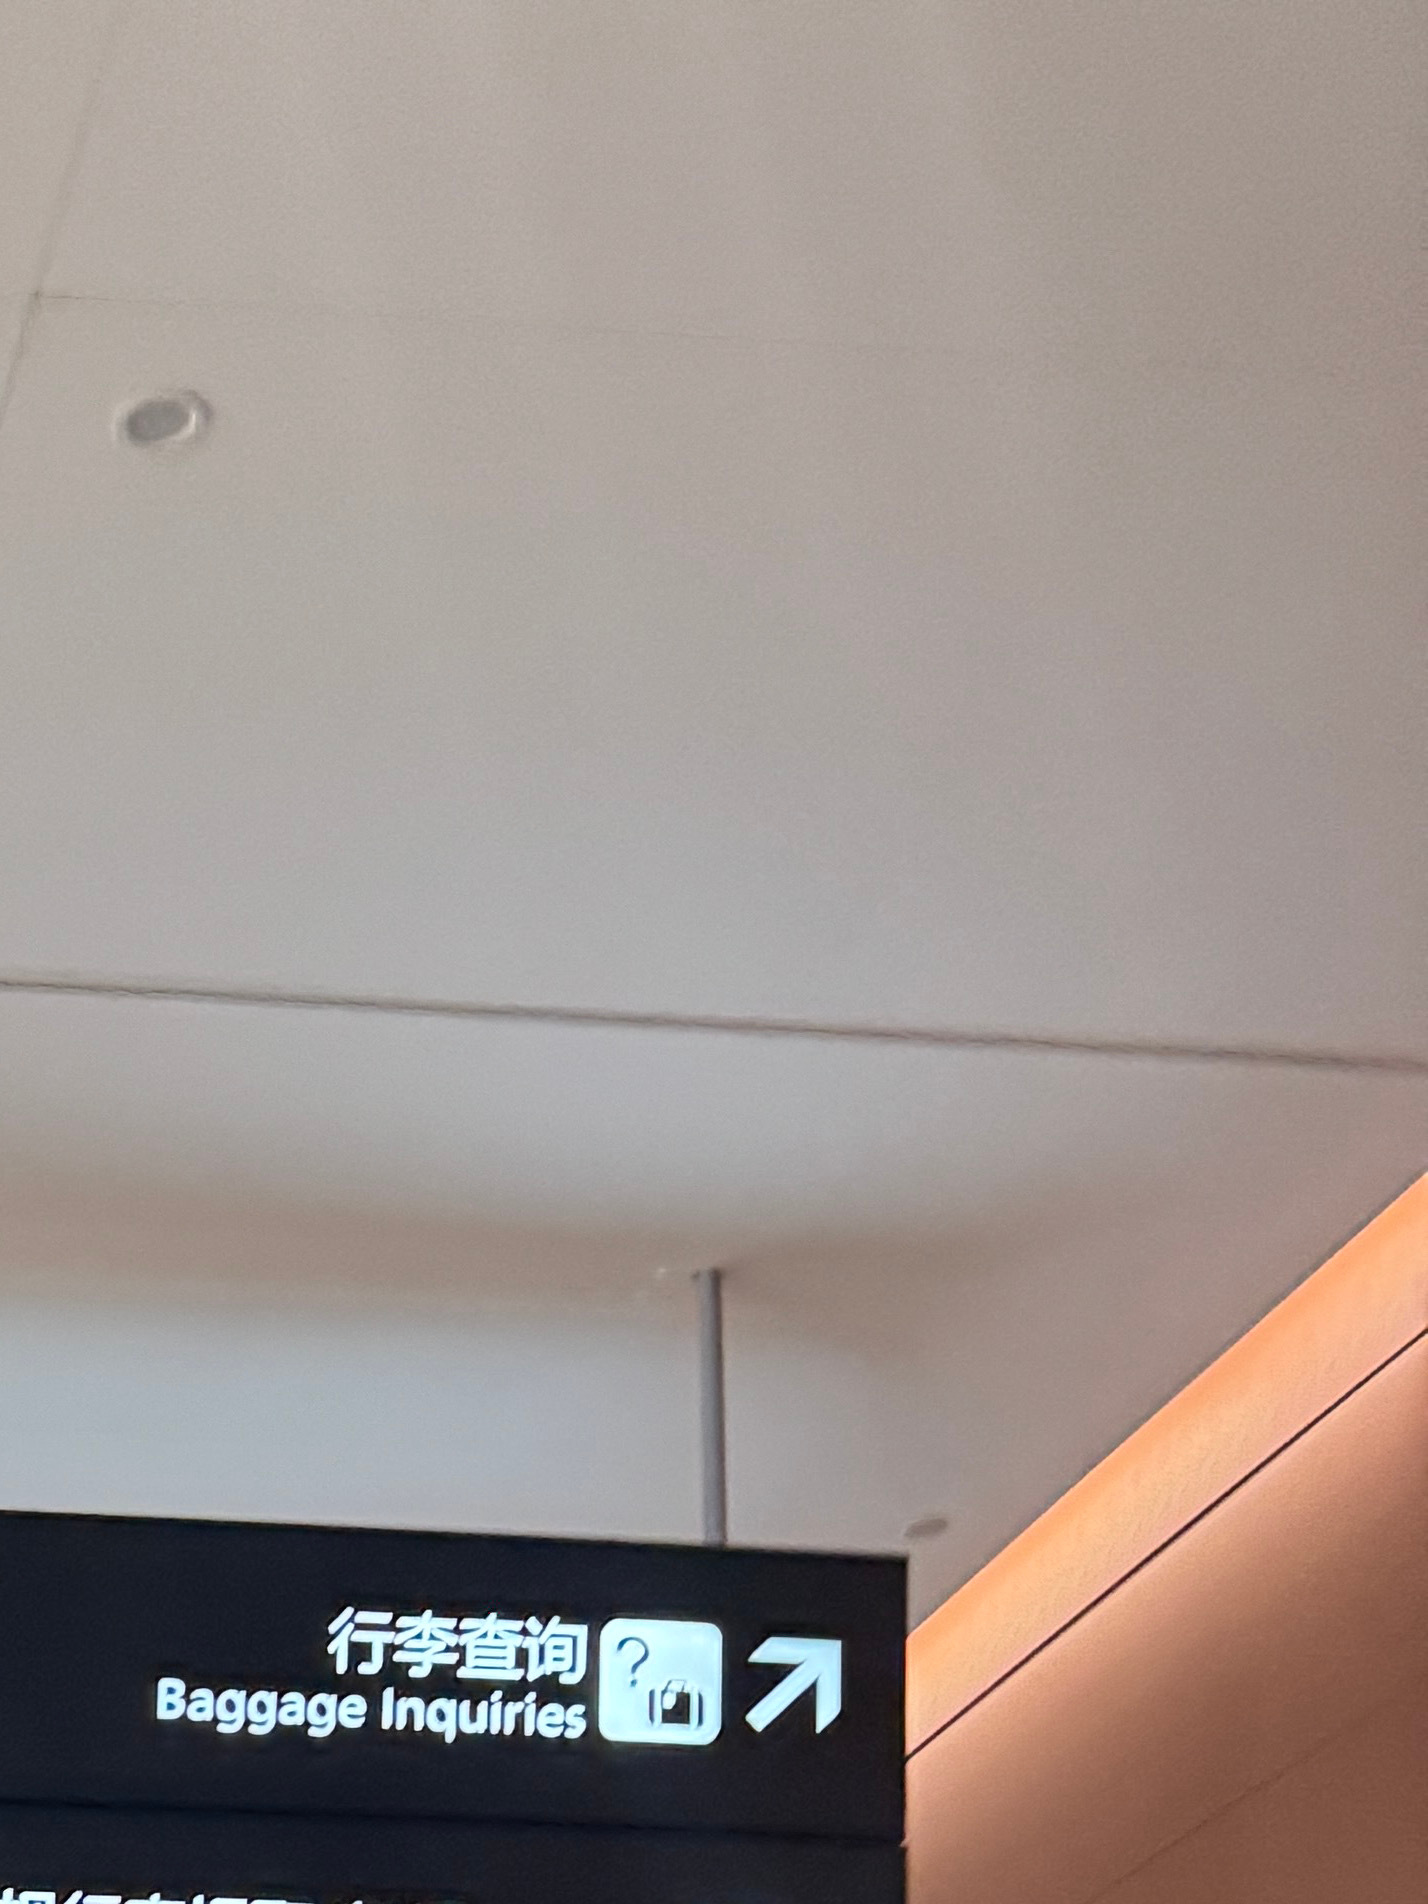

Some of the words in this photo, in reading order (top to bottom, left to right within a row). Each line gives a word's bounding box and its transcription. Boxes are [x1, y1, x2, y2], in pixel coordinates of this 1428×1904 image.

[327, 1606, 588, 1685] 行李查询
[156, 1677, 367, 1738] Baggage
[380, 1686, 587, 1743] Inquiries
